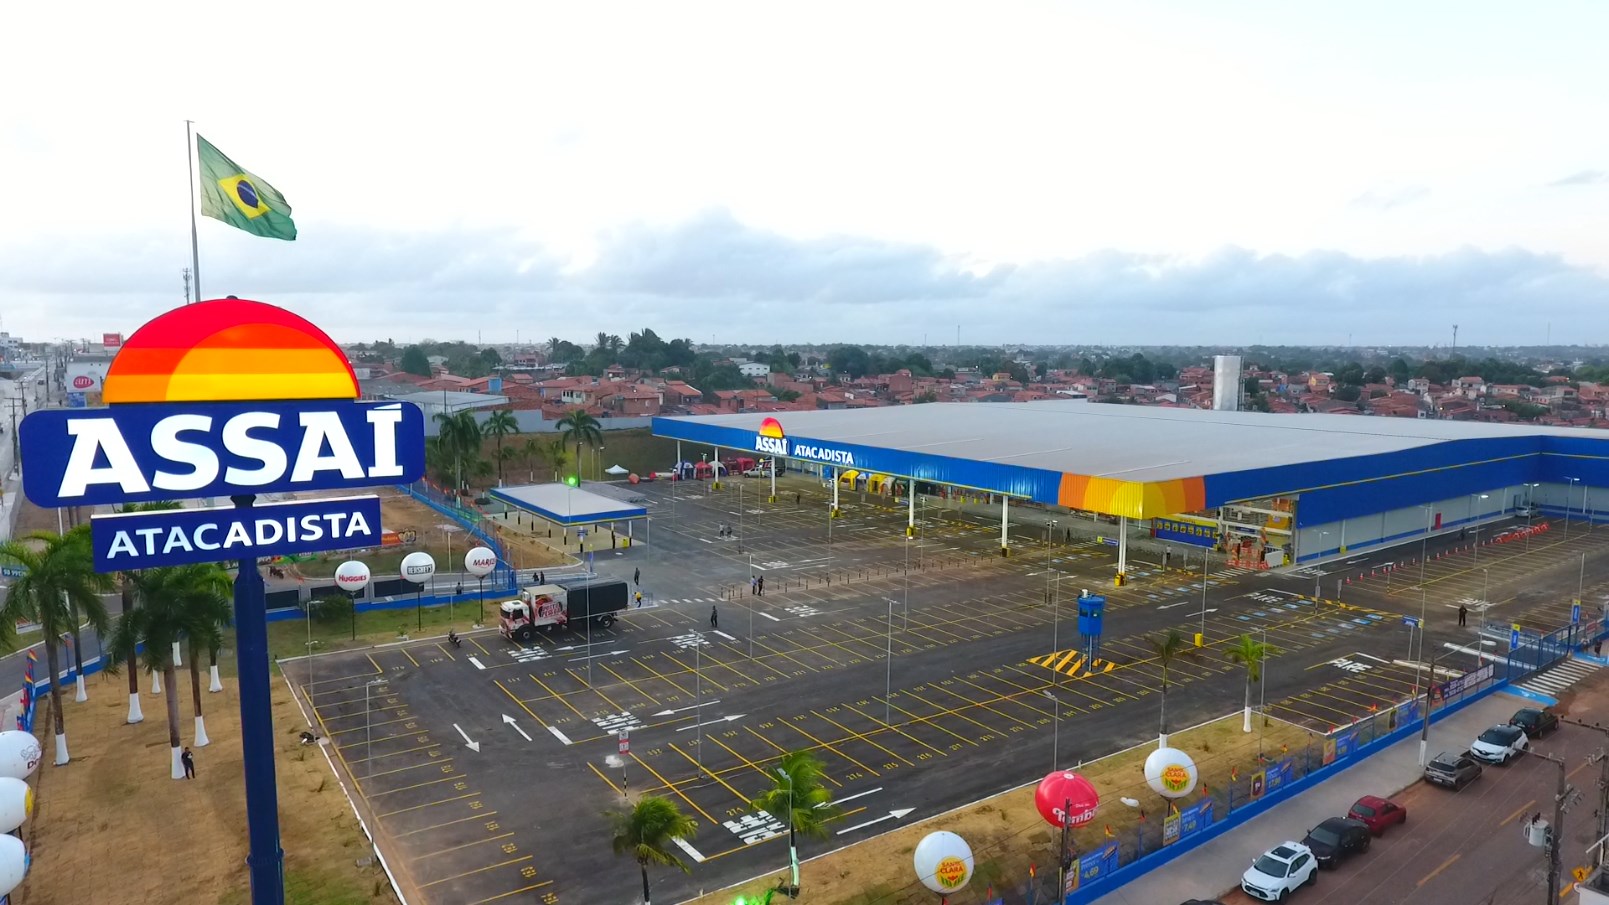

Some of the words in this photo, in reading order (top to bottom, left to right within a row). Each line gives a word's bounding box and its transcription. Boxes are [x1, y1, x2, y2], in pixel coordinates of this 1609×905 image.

[57, 403, 405, 498] ASSAÍ
[755, 435, 788, 455] ASSAÍ
[794, 444, 854, 464] ATACADISTA
[106, 511, 372, 560] ATACADISTA
[338, 574, 367, 583] HUGGIES
[1327, 658, 1373, 673] PARE
[726, 807, 744, 816] 271
[722, 810, 794, 845] PARE
